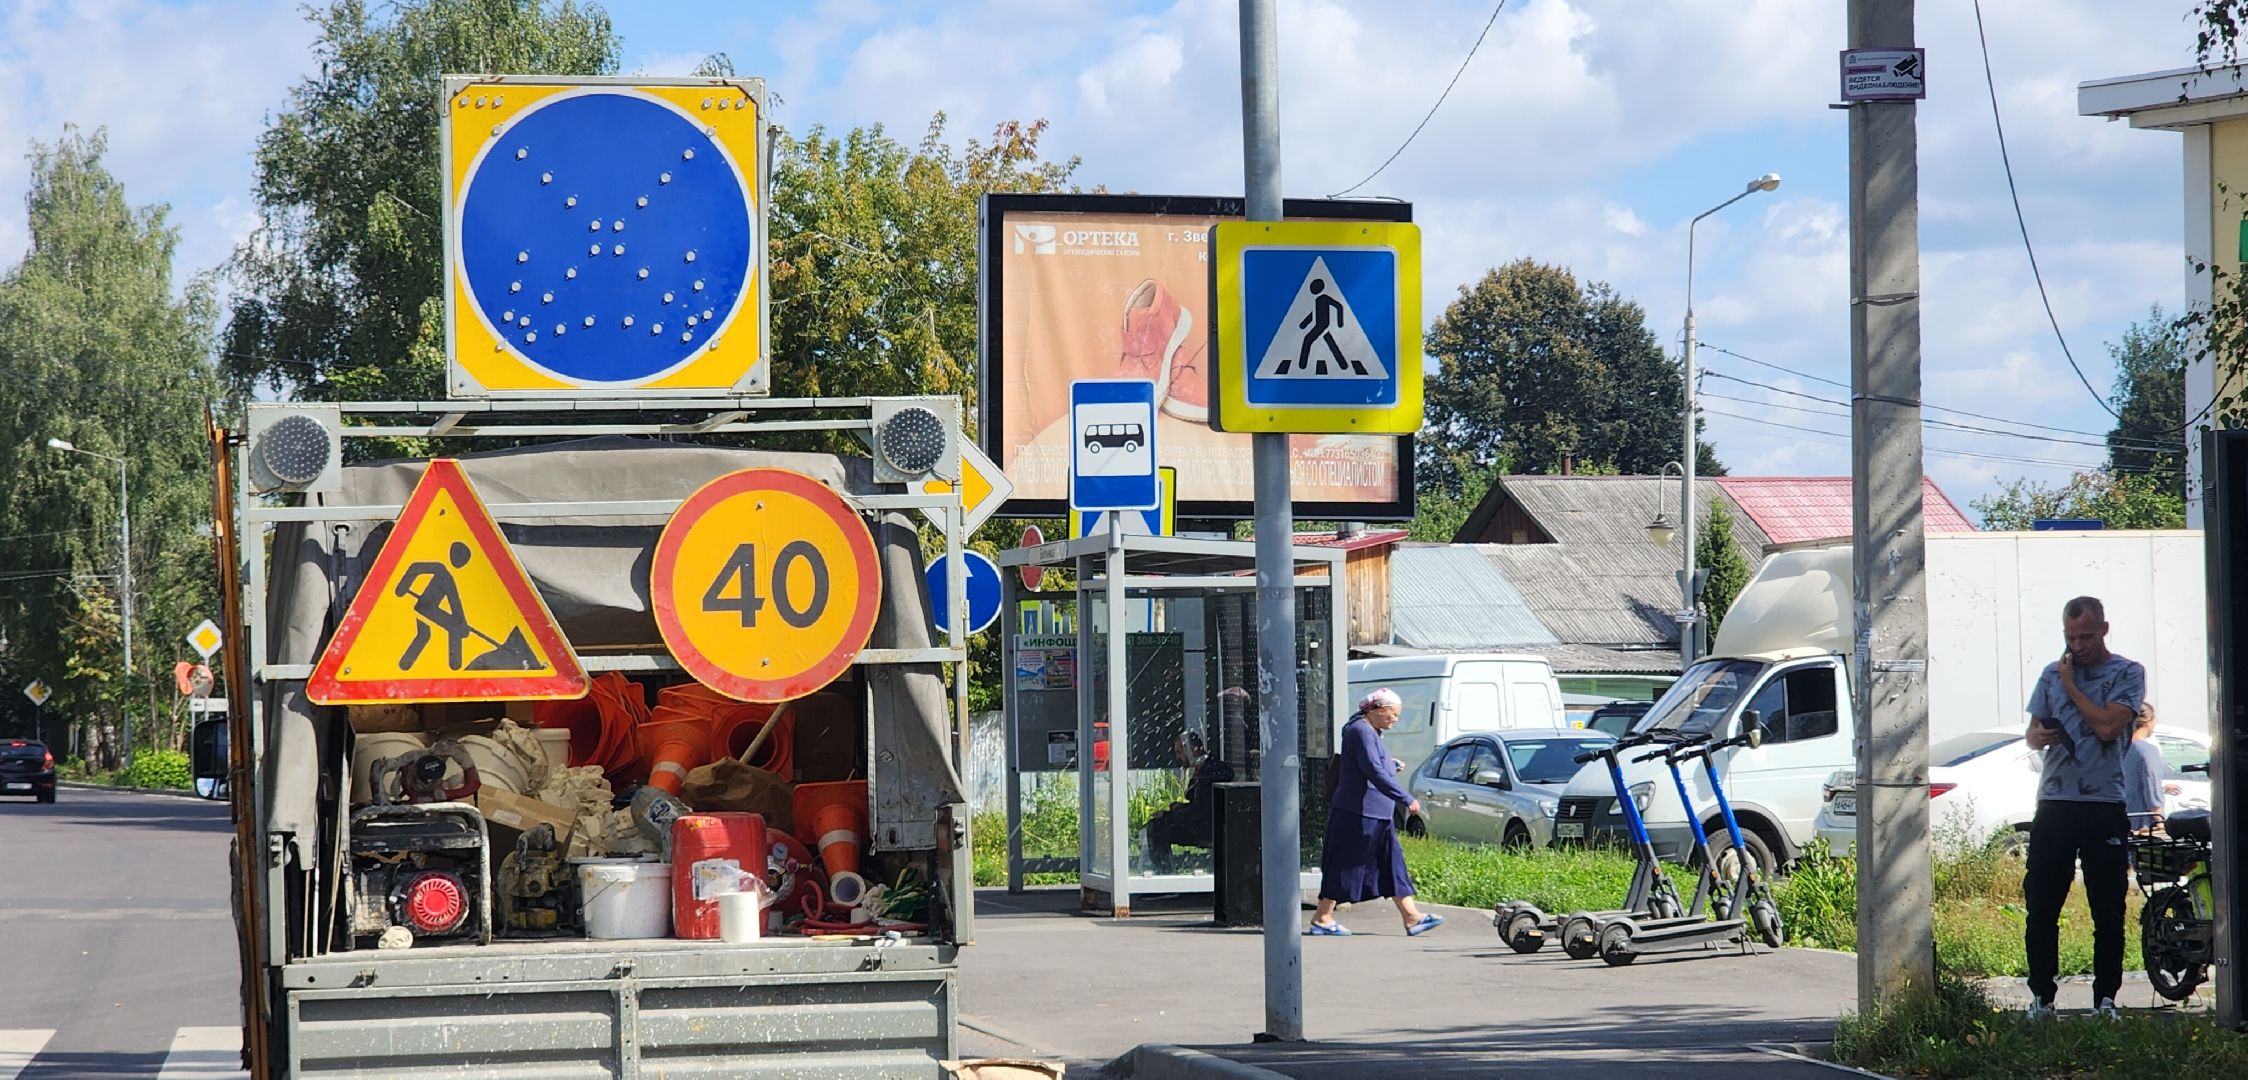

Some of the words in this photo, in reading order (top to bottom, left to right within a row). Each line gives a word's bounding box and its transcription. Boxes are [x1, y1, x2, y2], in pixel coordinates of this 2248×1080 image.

[1849, 75, 1880, 84] ВЕДЕТСЯ
[1063, 231, 1140, 246] ОРТЕКА
[1183, 231, 1208, 243] Зве
[703, 541, 829, 629] 40
